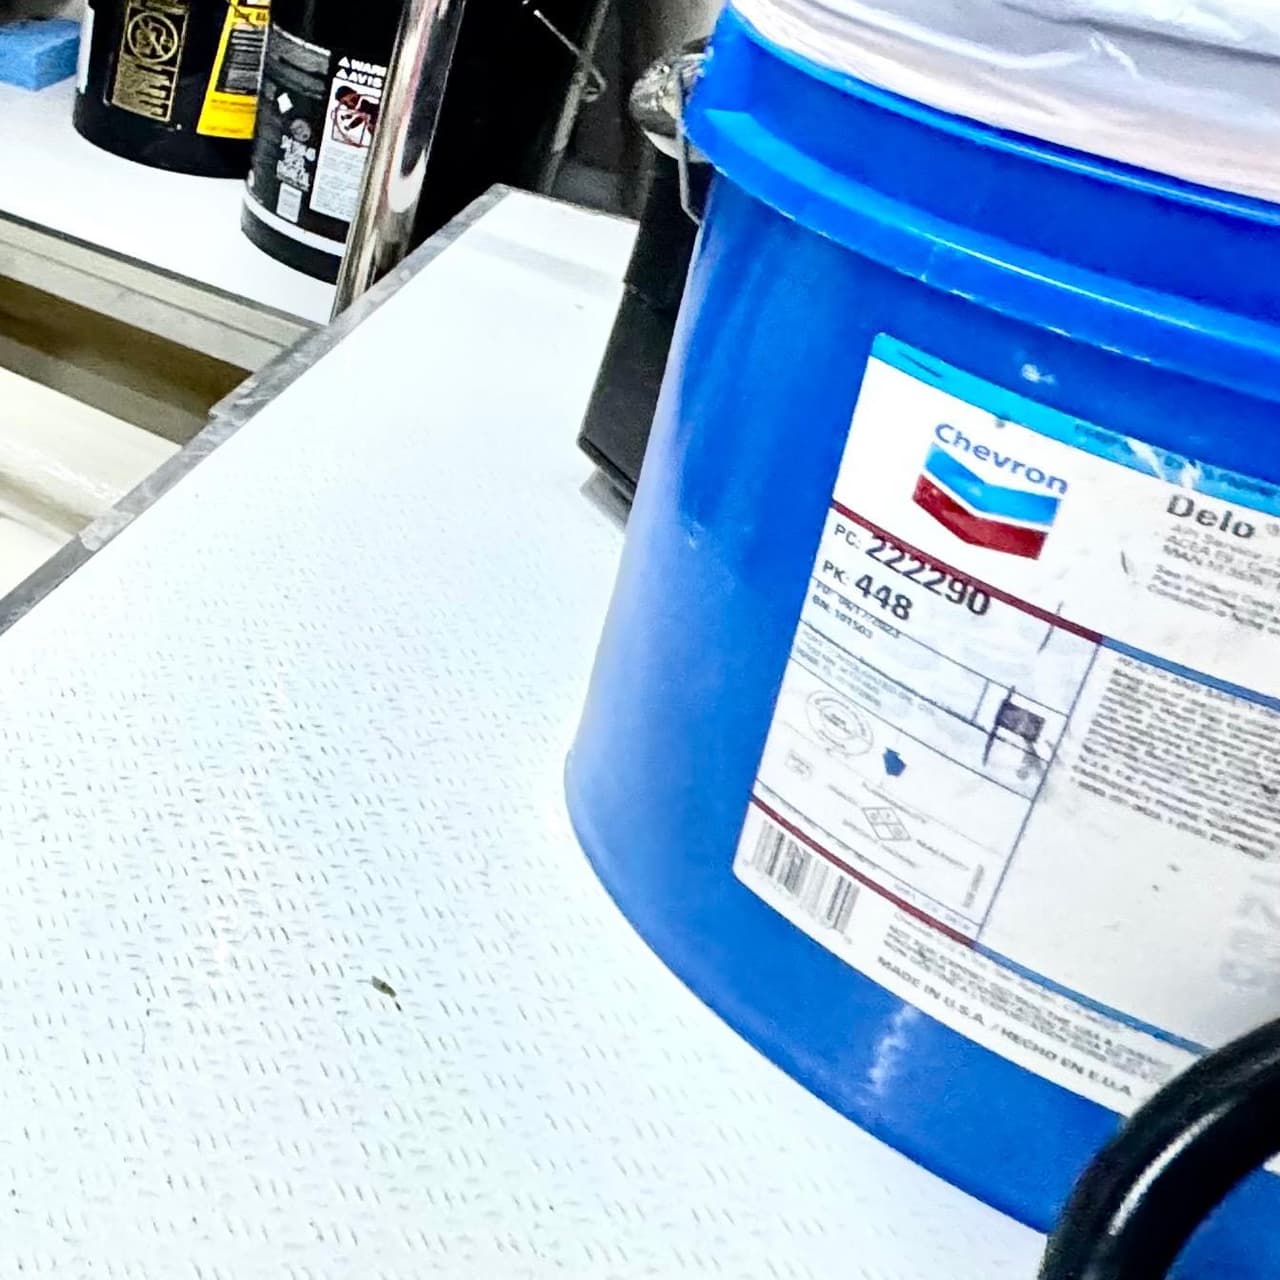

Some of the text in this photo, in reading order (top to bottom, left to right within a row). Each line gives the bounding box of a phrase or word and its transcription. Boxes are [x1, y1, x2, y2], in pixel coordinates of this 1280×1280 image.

[934, 422, 1069, 495] Chevron
[1166, 493, 1256, 539] Delo
[822, 559, 914, 621] PK: 448
[833, 523, 991, 616] PC: 222290
[877, 954, 920, 988] MADE
[924, 983, 941, 1002] IN
[1000, 1026, 1059, 1063] HECHO
[1060, 1056, 1085, 1076] EN
